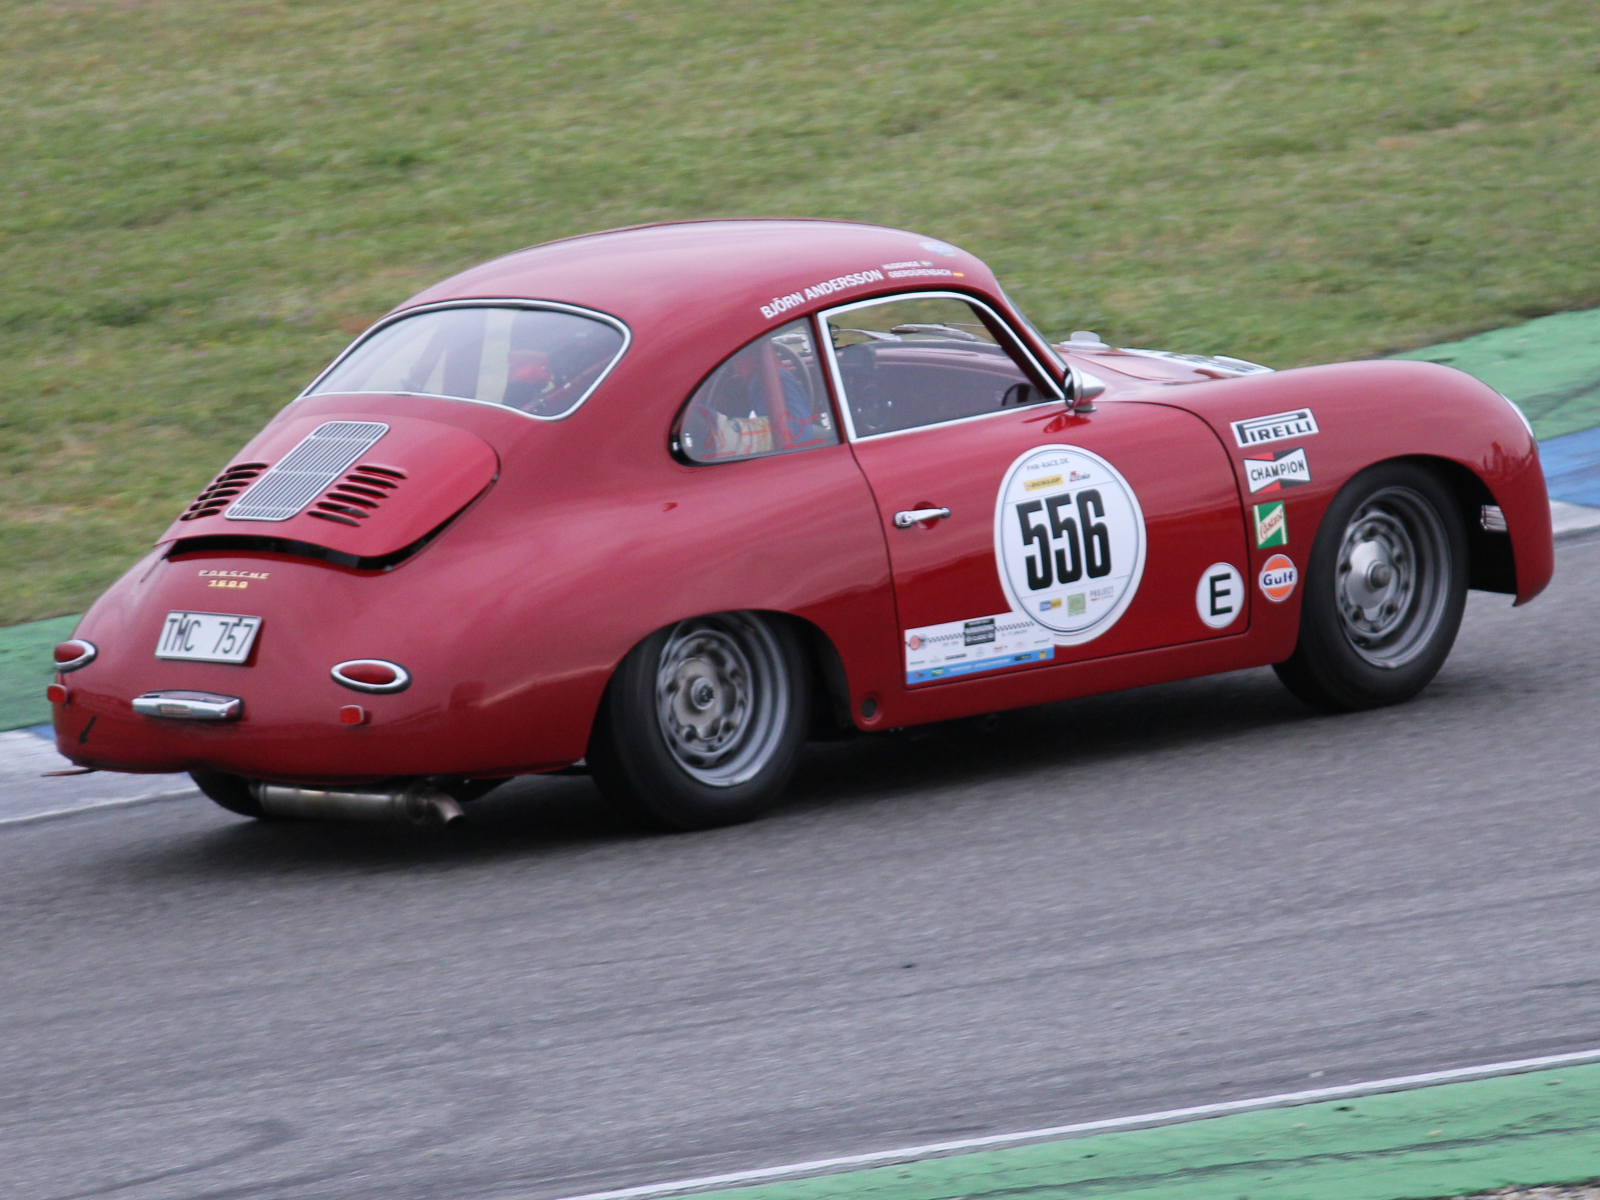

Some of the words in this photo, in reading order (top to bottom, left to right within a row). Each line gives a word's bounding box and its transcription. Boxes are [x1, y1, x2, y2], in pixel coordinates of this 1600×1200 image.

[760, 291, 806, 320] BJÖRN
[804, 269, 885, 301] ANDERSSON
[1236, 410, 1313, 445] PIRELLI
[1250, 459, 1305, 482] CHAMPION
[1016, 488, 1113, 591] 556
[1259, 508, 1284, 540] Castrol
[198, 570, 270, 579] PORSCHE
[208, 580, 248, 589] 1600
[1263, 571, 1295, 587] Gulf
[1209, 572, 1234, 617] E
[163, 618, 201, 651] TMC
[212, 621, 253, 654] 757
